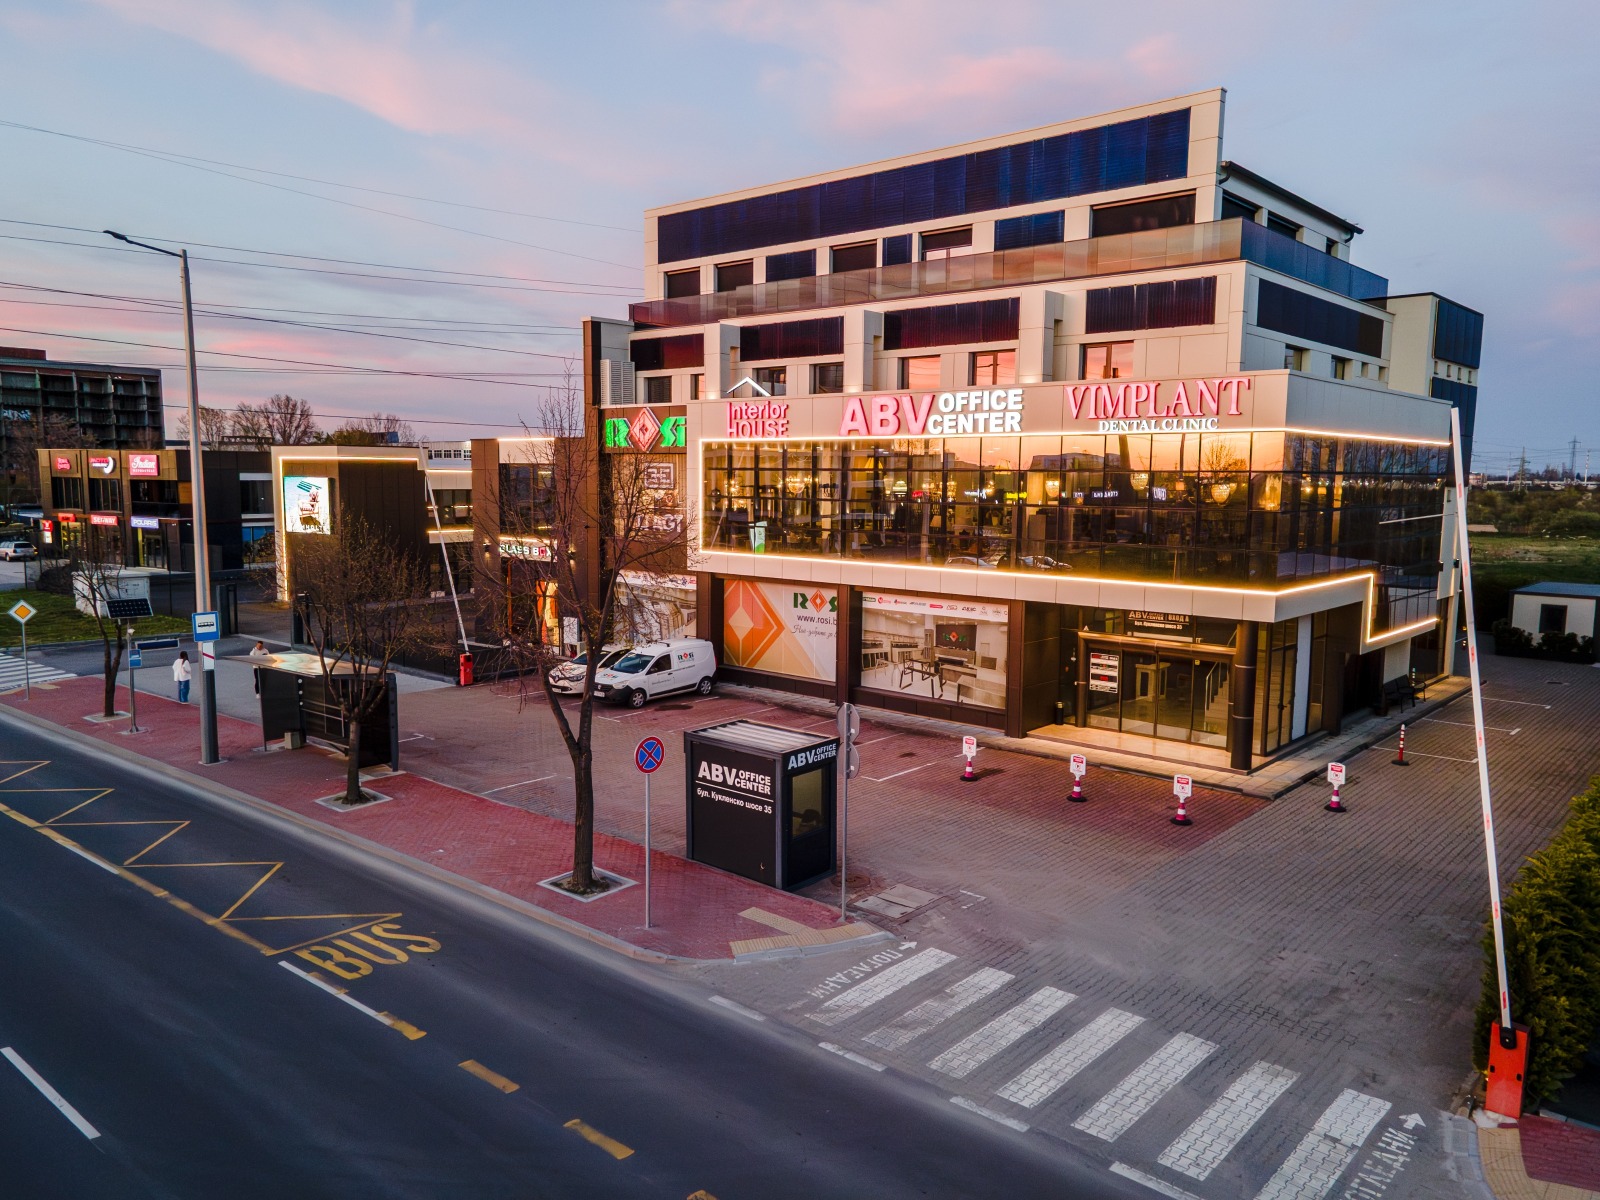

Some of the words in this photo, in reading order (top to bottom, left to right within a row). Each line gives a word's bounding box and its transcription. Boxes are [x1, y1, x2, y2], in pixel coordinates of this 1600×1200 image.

[938, 389, 1023, 413] OFFICE
[1064, 377, 1250, 419] VIMPLANT
[727, 400, 789, 420] Interior
[839, 393, 936, 437] ABV
[727, 419, 789, 438] HOUSE
[927, 411, 1022, 435] CENTER
[1098, 419, 1160, 432] DENTAL
[1162, 418, 1218, 431] CLINIC
[131, 456, 156, 469] Indian
[133, 518, 157, 527] POLARIS
[1128, 610, 1148, 619] ABV
[814, 750, 837, 762] CENTER
[816, 743, 837, 755] OFFICE
[787, 749, 815, 770] ABV
[698, 760, 737, 786] ABV
[738, 769, 771, 786] OFFICE
[734, 778, 771, 795] CENTER
[696, 787, 710, 798] бул.
[711, 791, 744, 807] Кукленско
[745, 802, 763, 812] шосе
[763, 805, 772, 814] 35
[293, 923, 442, 980] BUS
[806, 949, 904, 999] ПОГЛЕДНИ
[1340, 1127, 1418, 1200] ОГЛЕДНИ
